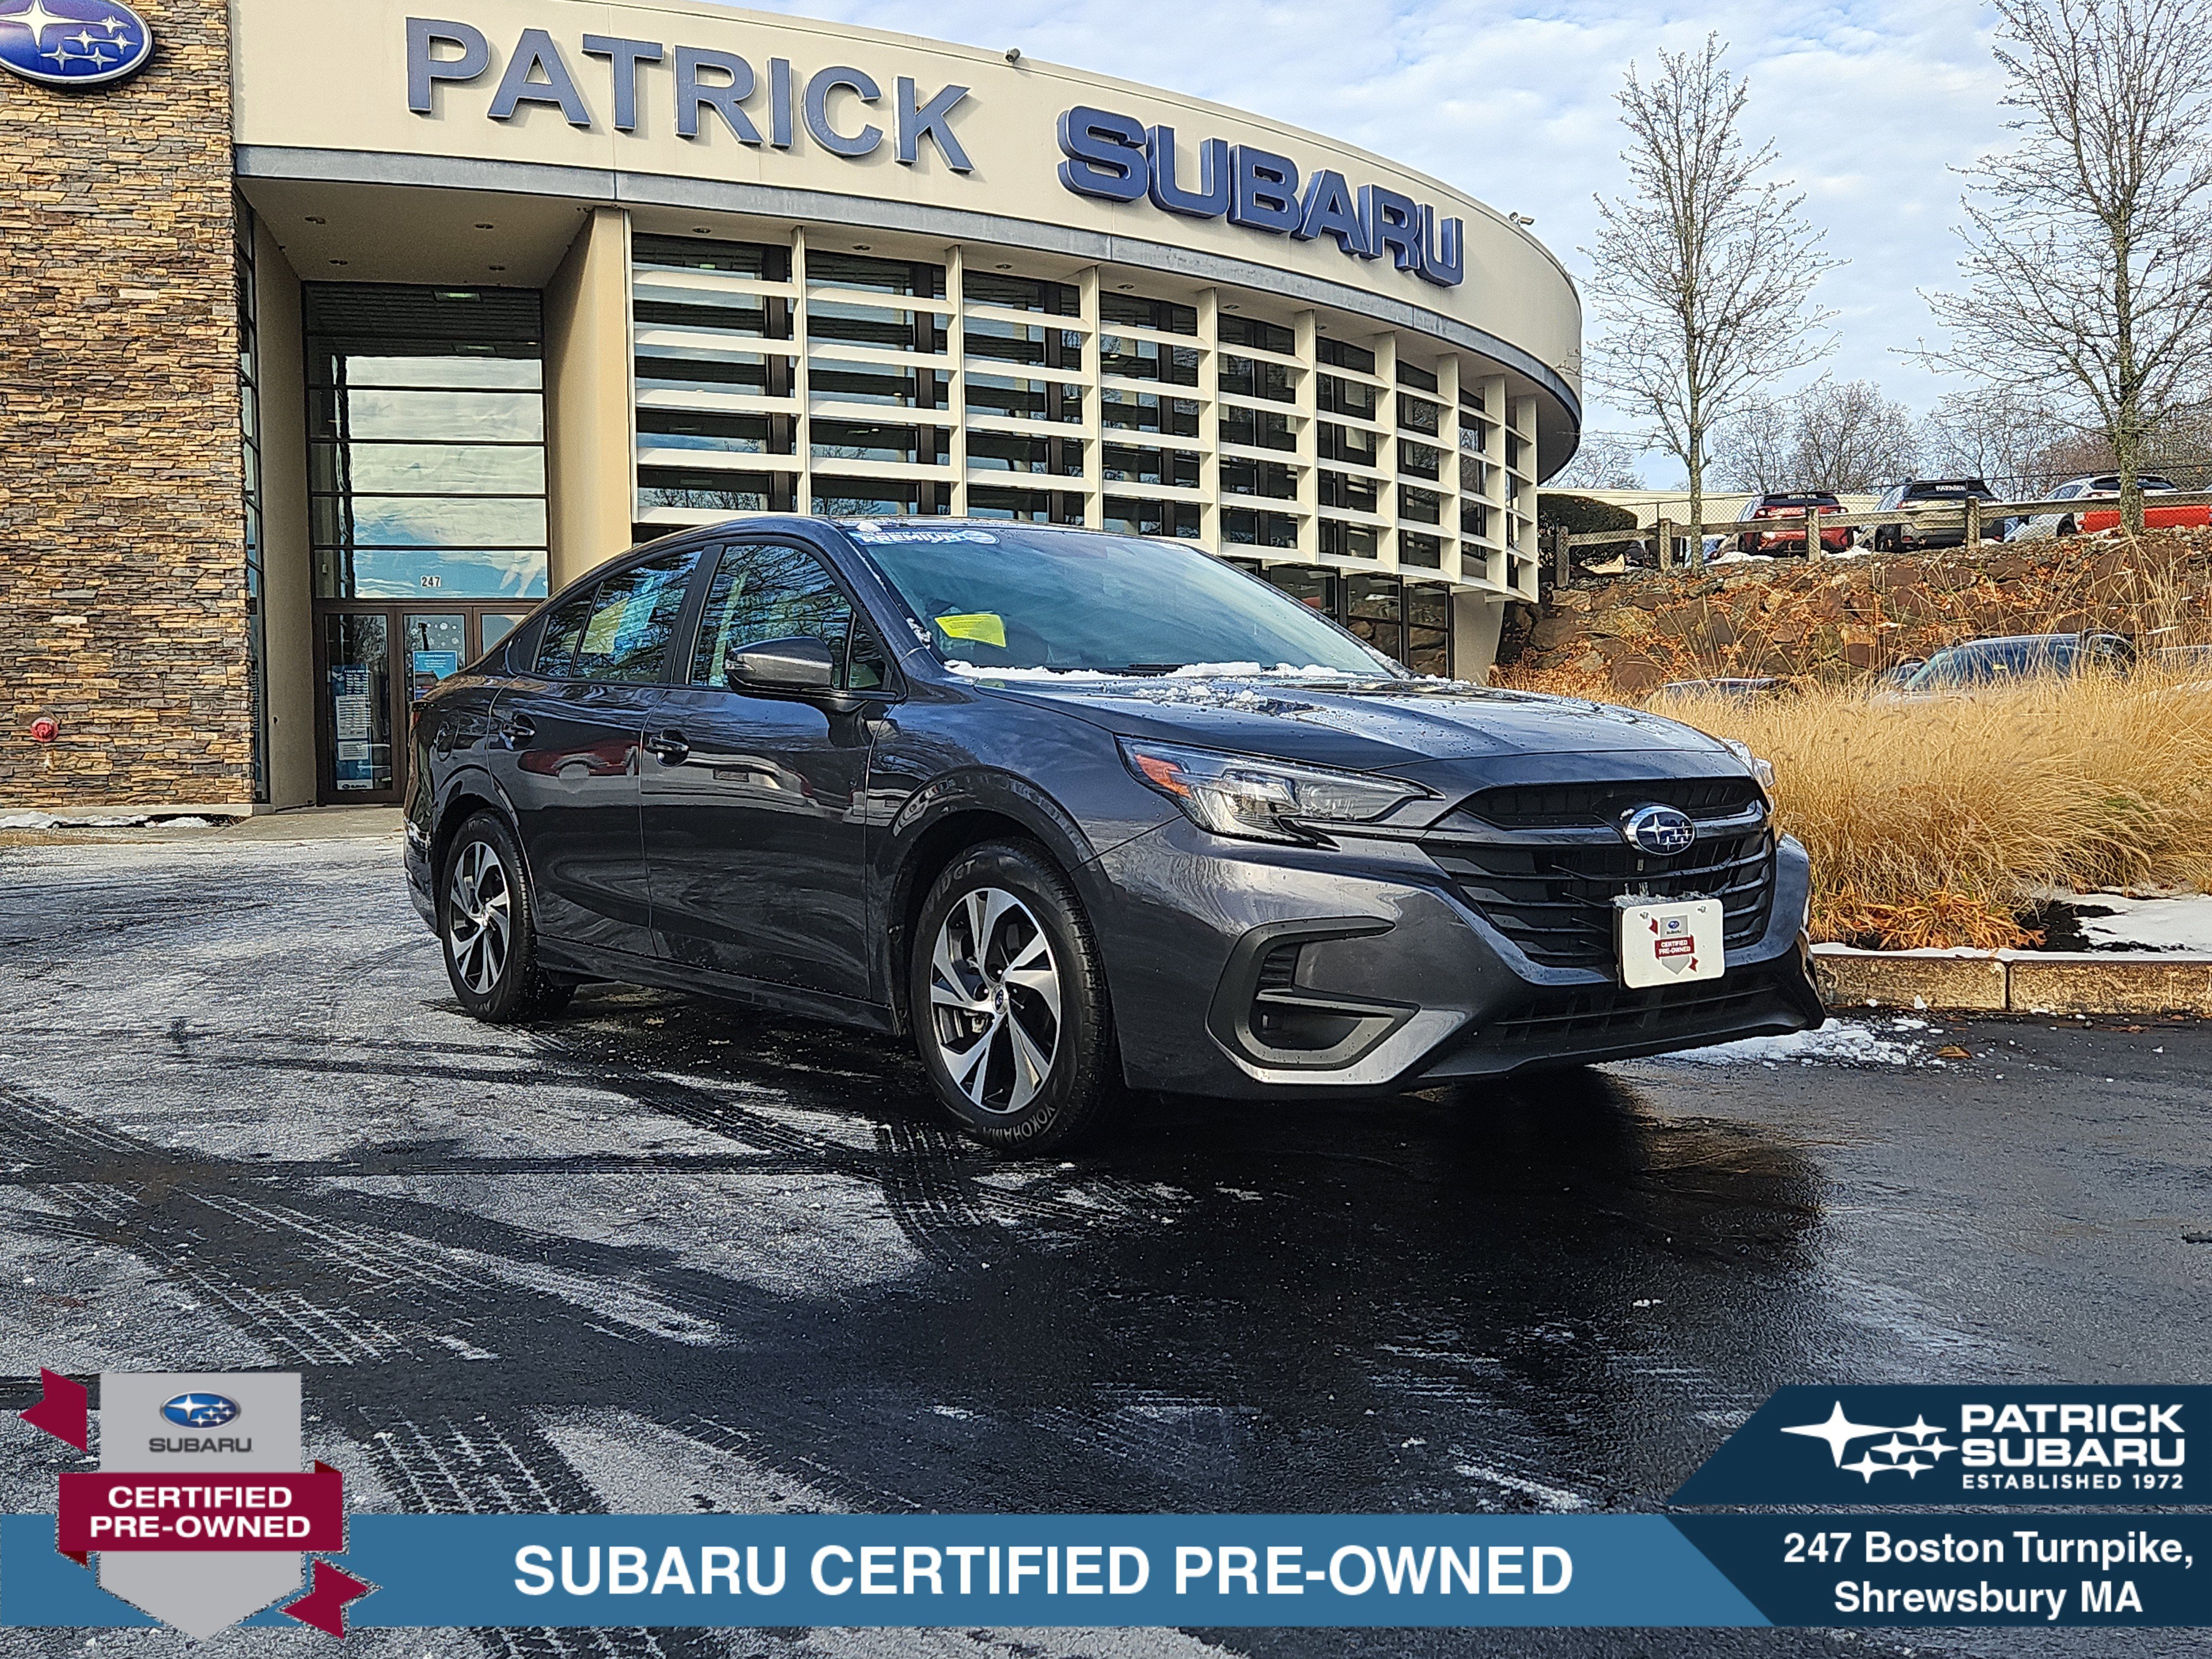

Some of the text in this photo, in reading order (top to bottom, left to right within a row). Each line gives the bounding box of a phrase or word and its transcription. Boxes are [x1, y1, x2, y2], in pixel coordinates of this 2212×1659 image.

[405, 16, 1465, 287] PATRICK SUBARU
[860, 533, 961, 543] PREMIUM
[421, 576, 440, 587] 247
[982, 1102, 1057, 1142] YOKOHAMA
